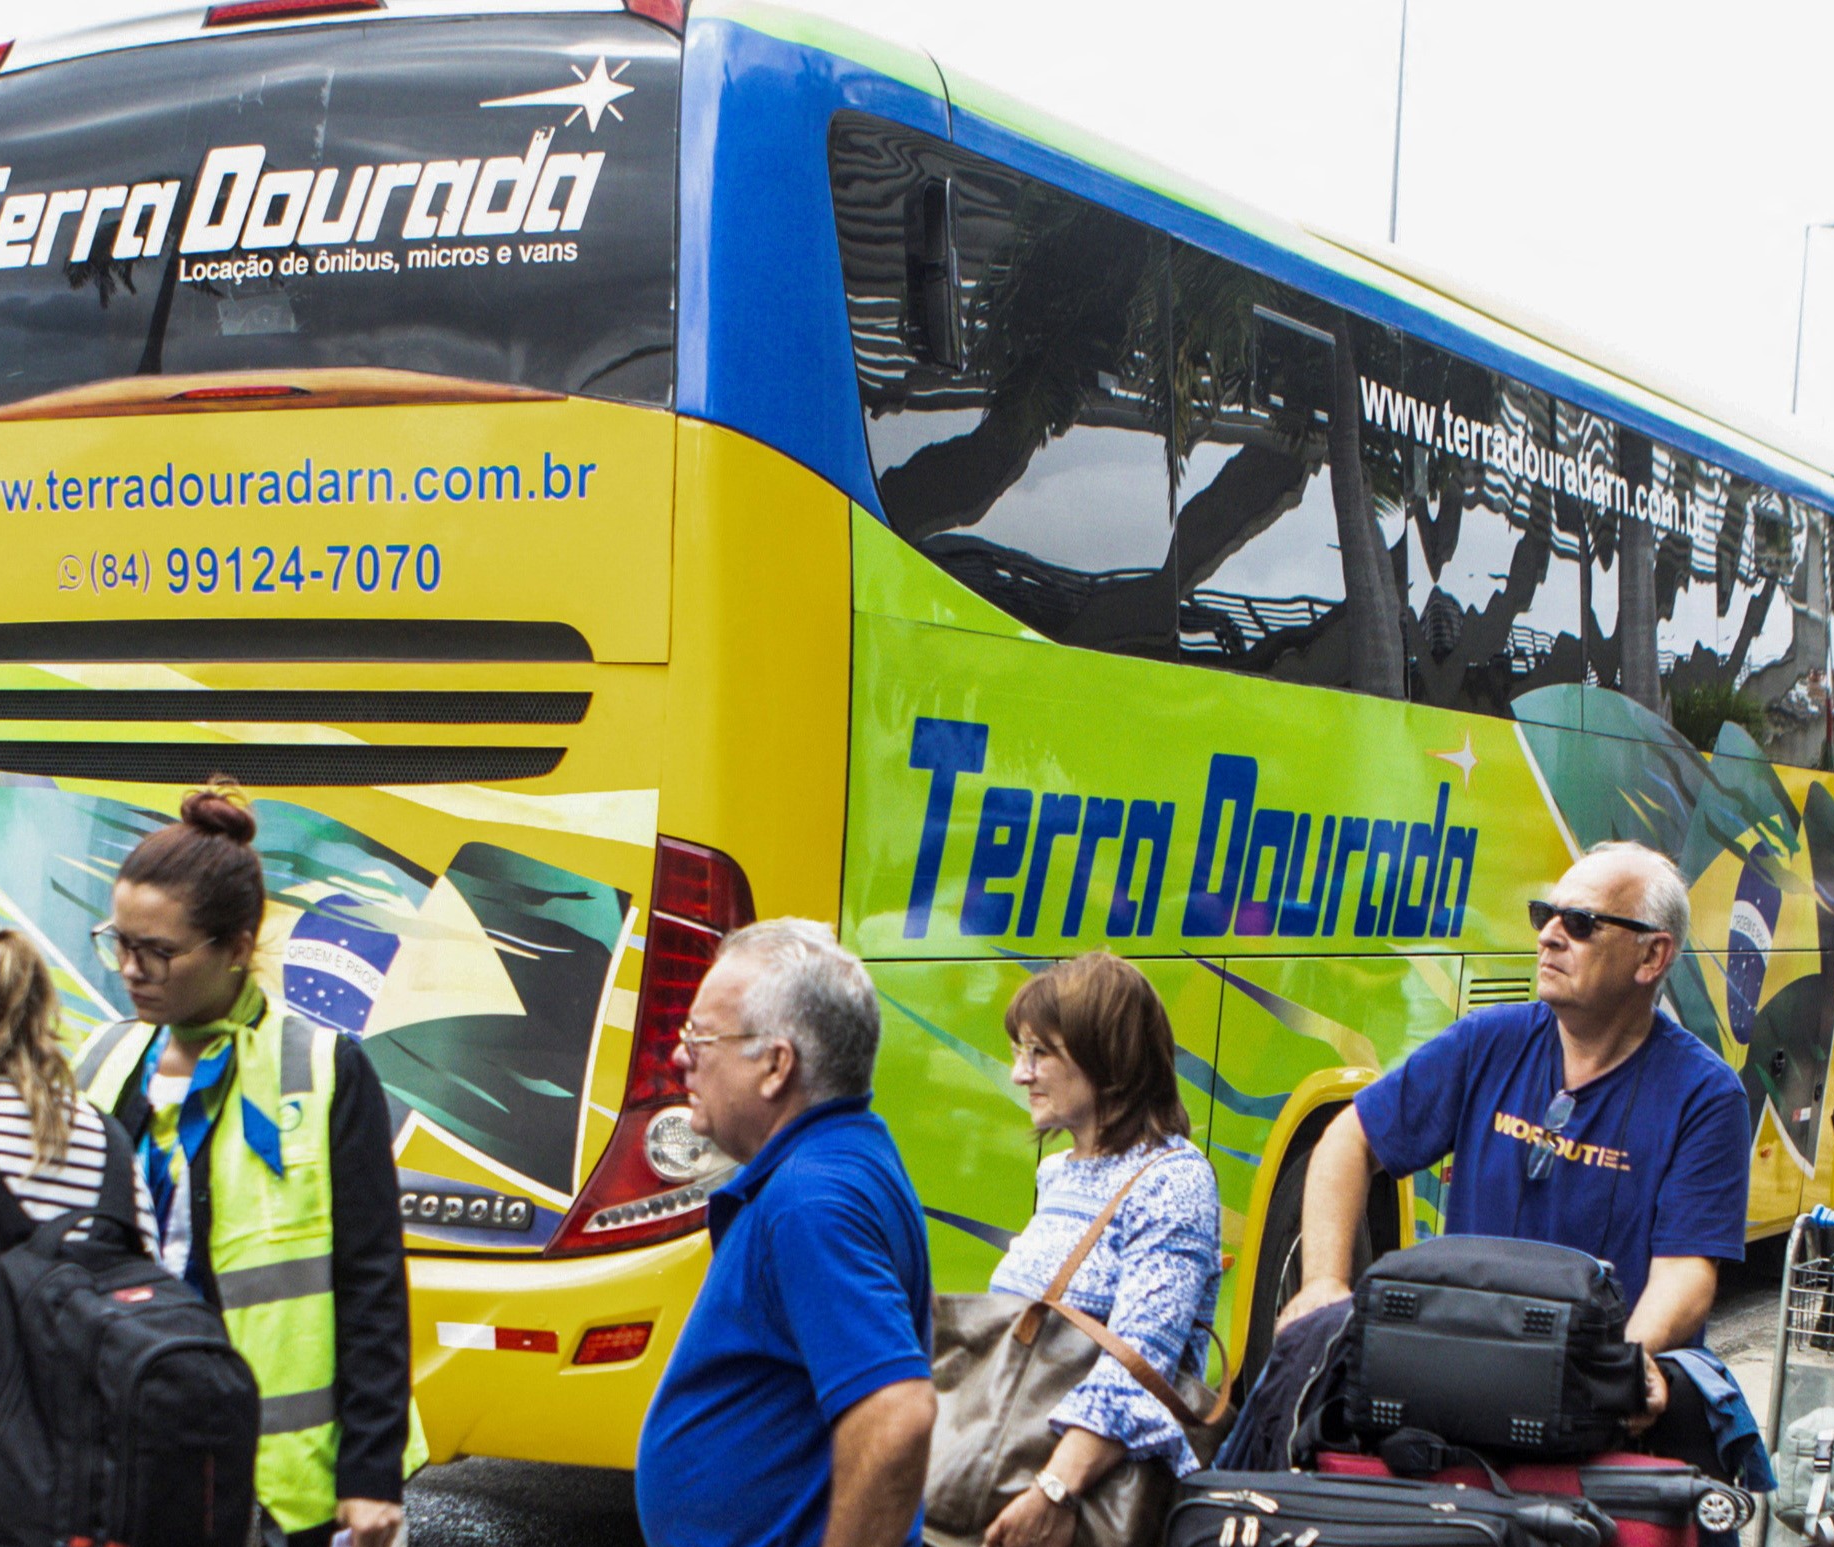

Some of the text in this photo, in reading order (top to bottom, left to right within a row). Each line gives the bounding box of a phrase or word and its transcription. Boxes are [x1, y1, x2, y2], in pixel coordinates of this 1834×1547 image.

[179, 126, 605, 254] Dourada
[179, 241, 579, 285] Locação de ônibus, micros e vans
[1359, 375, 1709, 539] www.terradouradarn.com.br
[89, 543, 442, 595] (84) 99124-7070
[902, 716, 1479, 940] Terra Dourada
[288, 945, 332, 962] ORDEM
[335, 954, 343, 968] E
